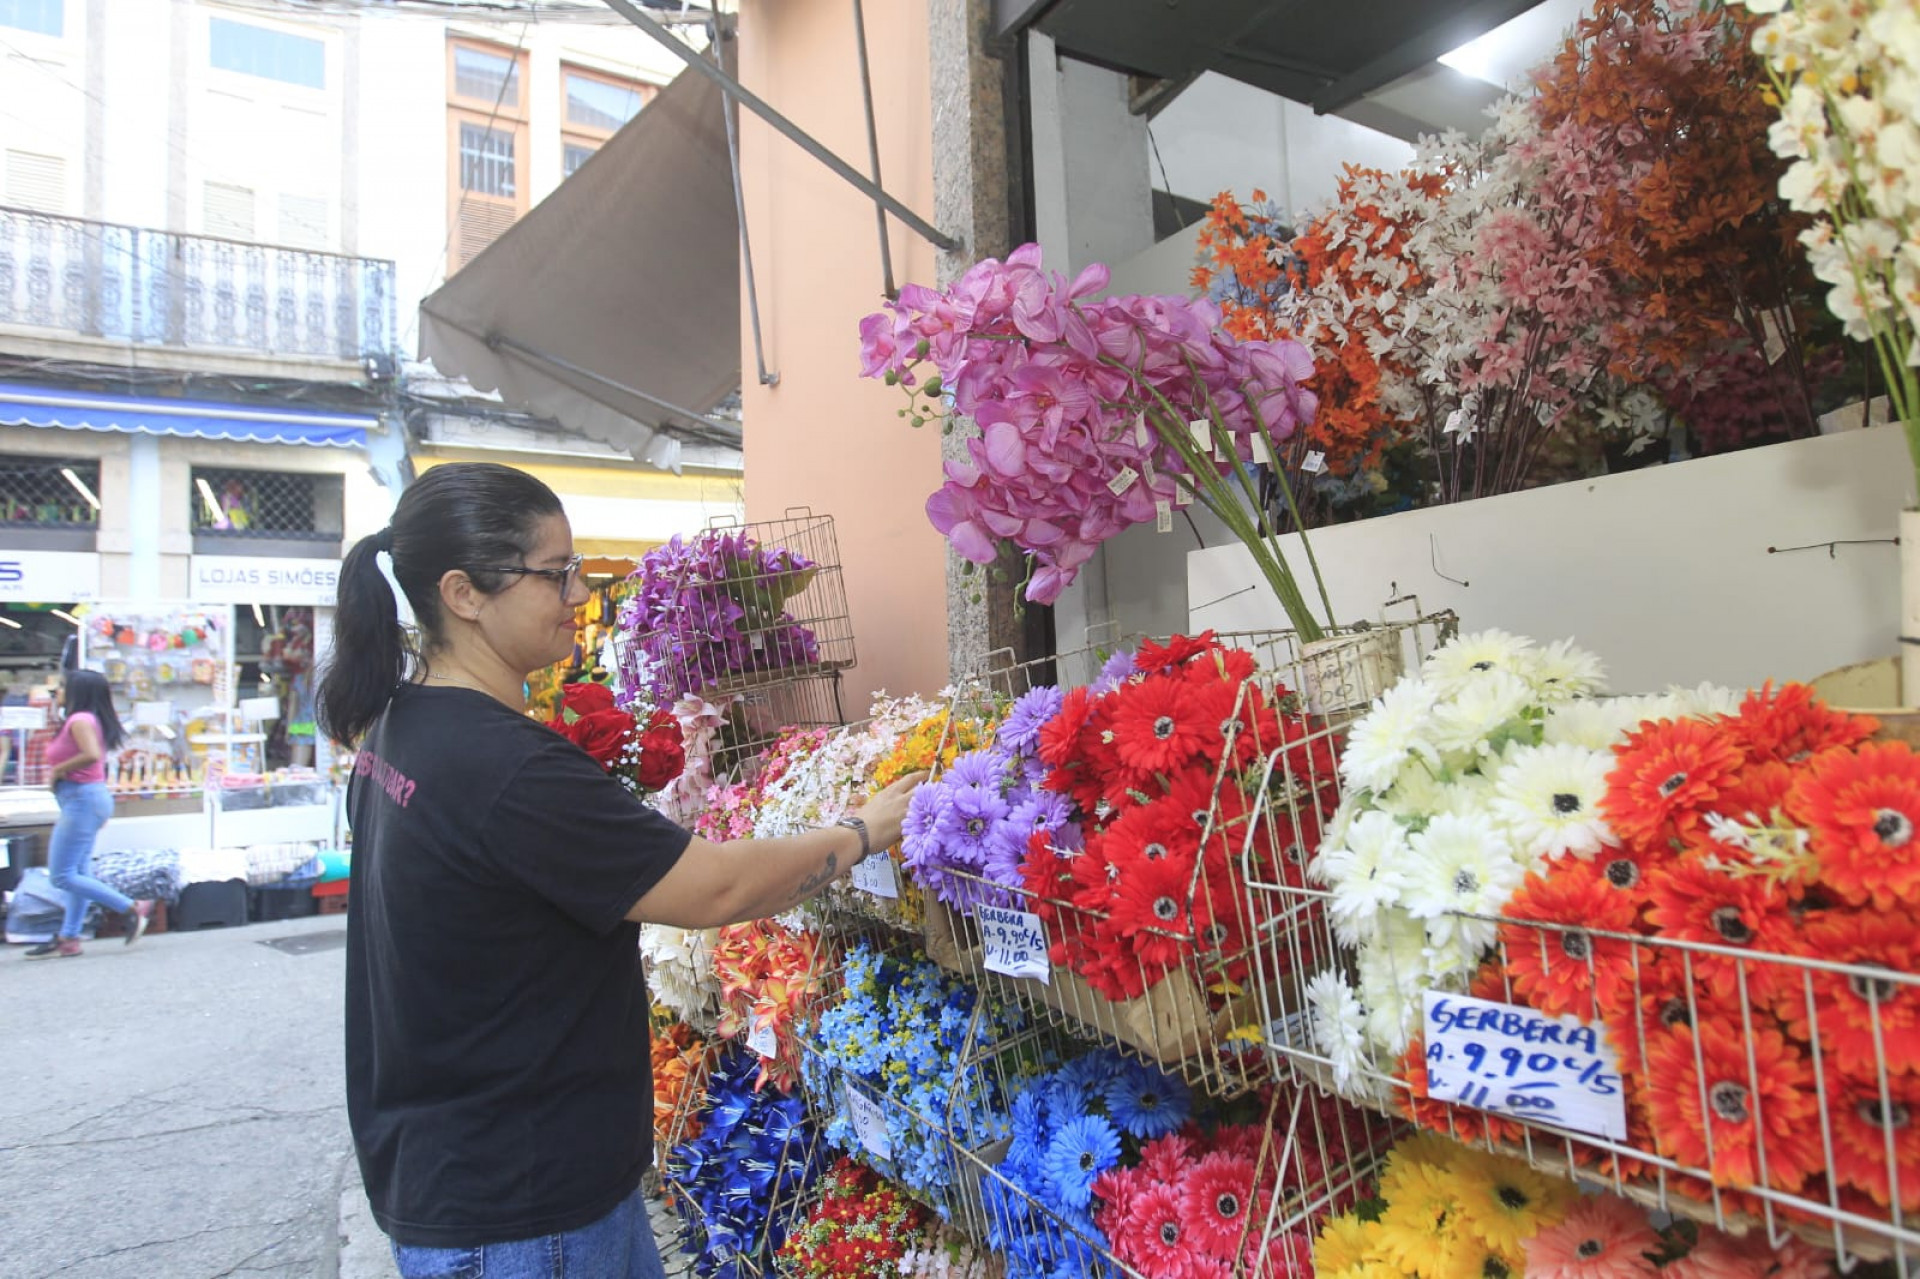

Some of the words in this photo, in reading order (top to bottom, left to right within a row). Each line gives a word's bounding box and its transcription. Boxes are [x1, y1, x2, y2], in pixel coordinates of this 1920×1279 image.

[200, 569, 260, 584] LOJAS
[268, 568, 337, 586] SIMÕES
[1430, 998, 1597, 1053] GERBERA
